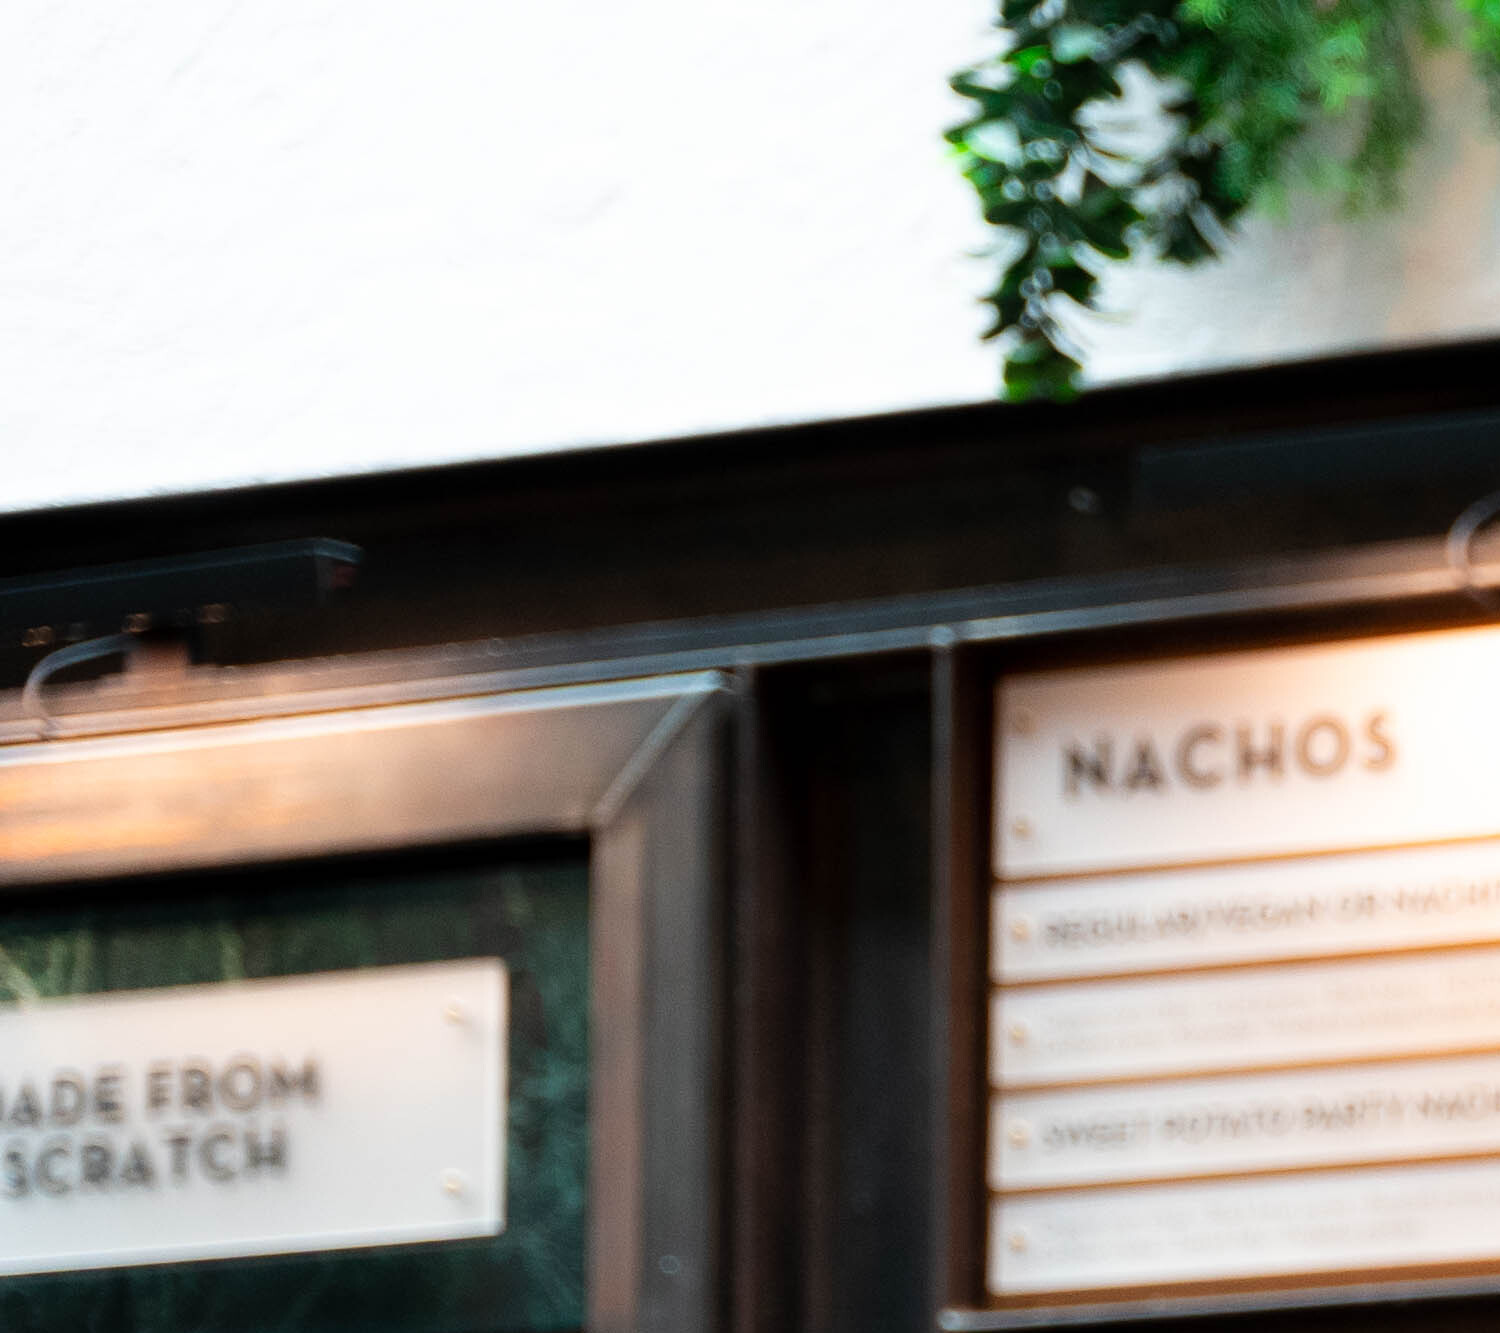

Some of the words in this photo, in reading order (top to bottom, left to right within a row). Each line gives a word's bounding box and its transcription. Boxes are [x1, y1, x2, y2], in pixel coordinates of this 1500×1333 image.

[1061, 708, 1399, 800] NACHOS
[0, 1062, 125, 1127] ADE
[145, 1052, 321, 1116] FROM
[3, 1124, 288, 1196] SCRATCH
